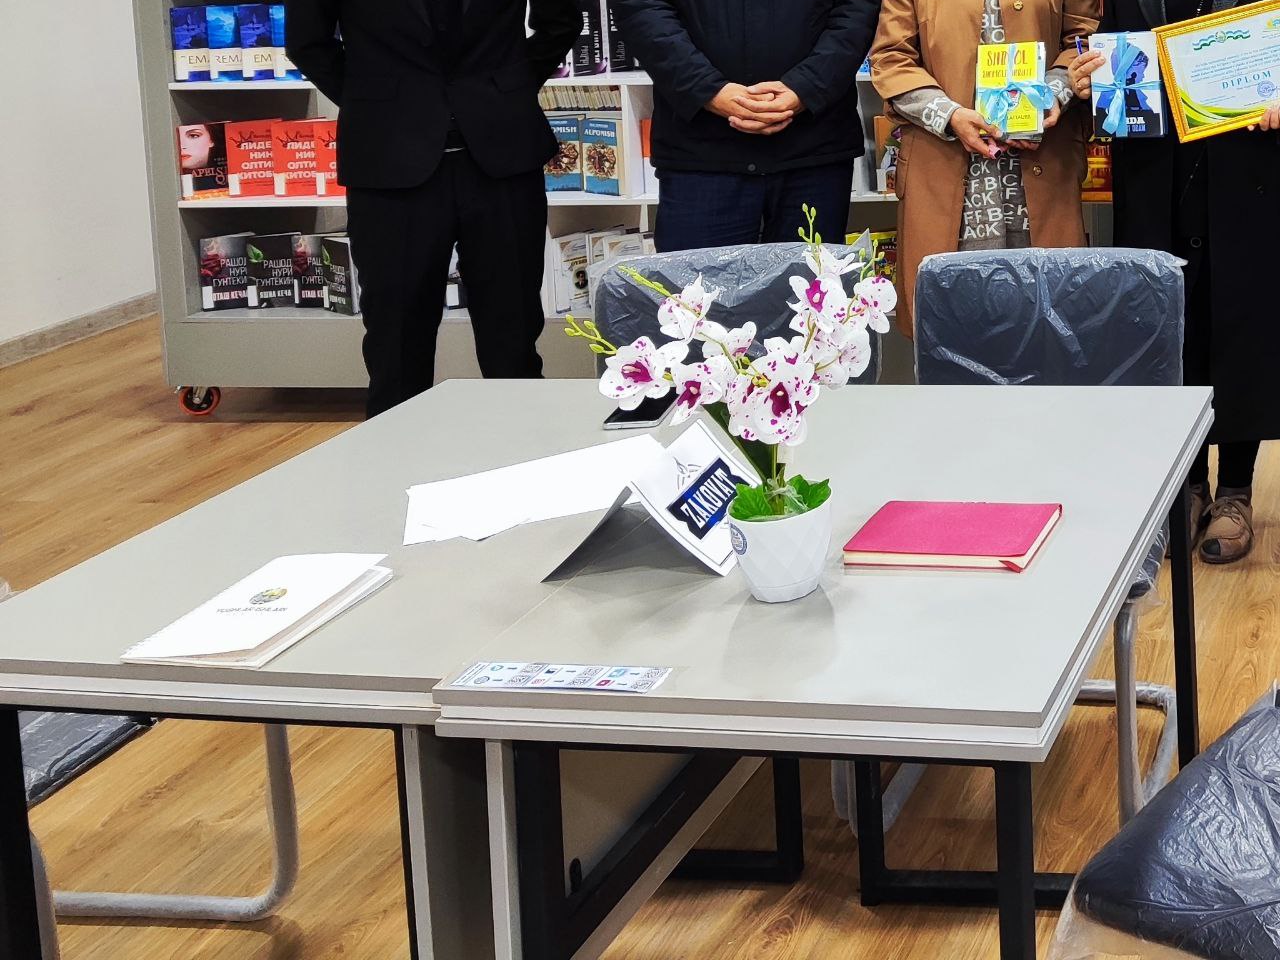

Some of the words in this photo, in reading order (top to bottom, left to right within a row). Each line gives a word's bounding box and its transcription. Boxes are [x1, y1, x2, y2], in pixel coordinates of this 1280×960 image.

[1222, 70, 1272, 89] DIPLOM
[240, 141, 272, 150] ЛИДЕ
[250, 151, 273, 159] НИН
[241, 162, 273, 170] ОЛТИ
[287, 161, 317, 169] ОЛТИ
[237, 171, 273, 180] КИТОБ
[963, 221, 1001, 240] ACK
[263, 259, 292, 268] РАШОД
[272, 268, 293, 277] НУРИ
[213, 276, 247, 287] ГУНТЕКИ
[256, 277, 294, 287] ГУНТЕКИН
[680, 468, 737, 529] ZAKOVAT
